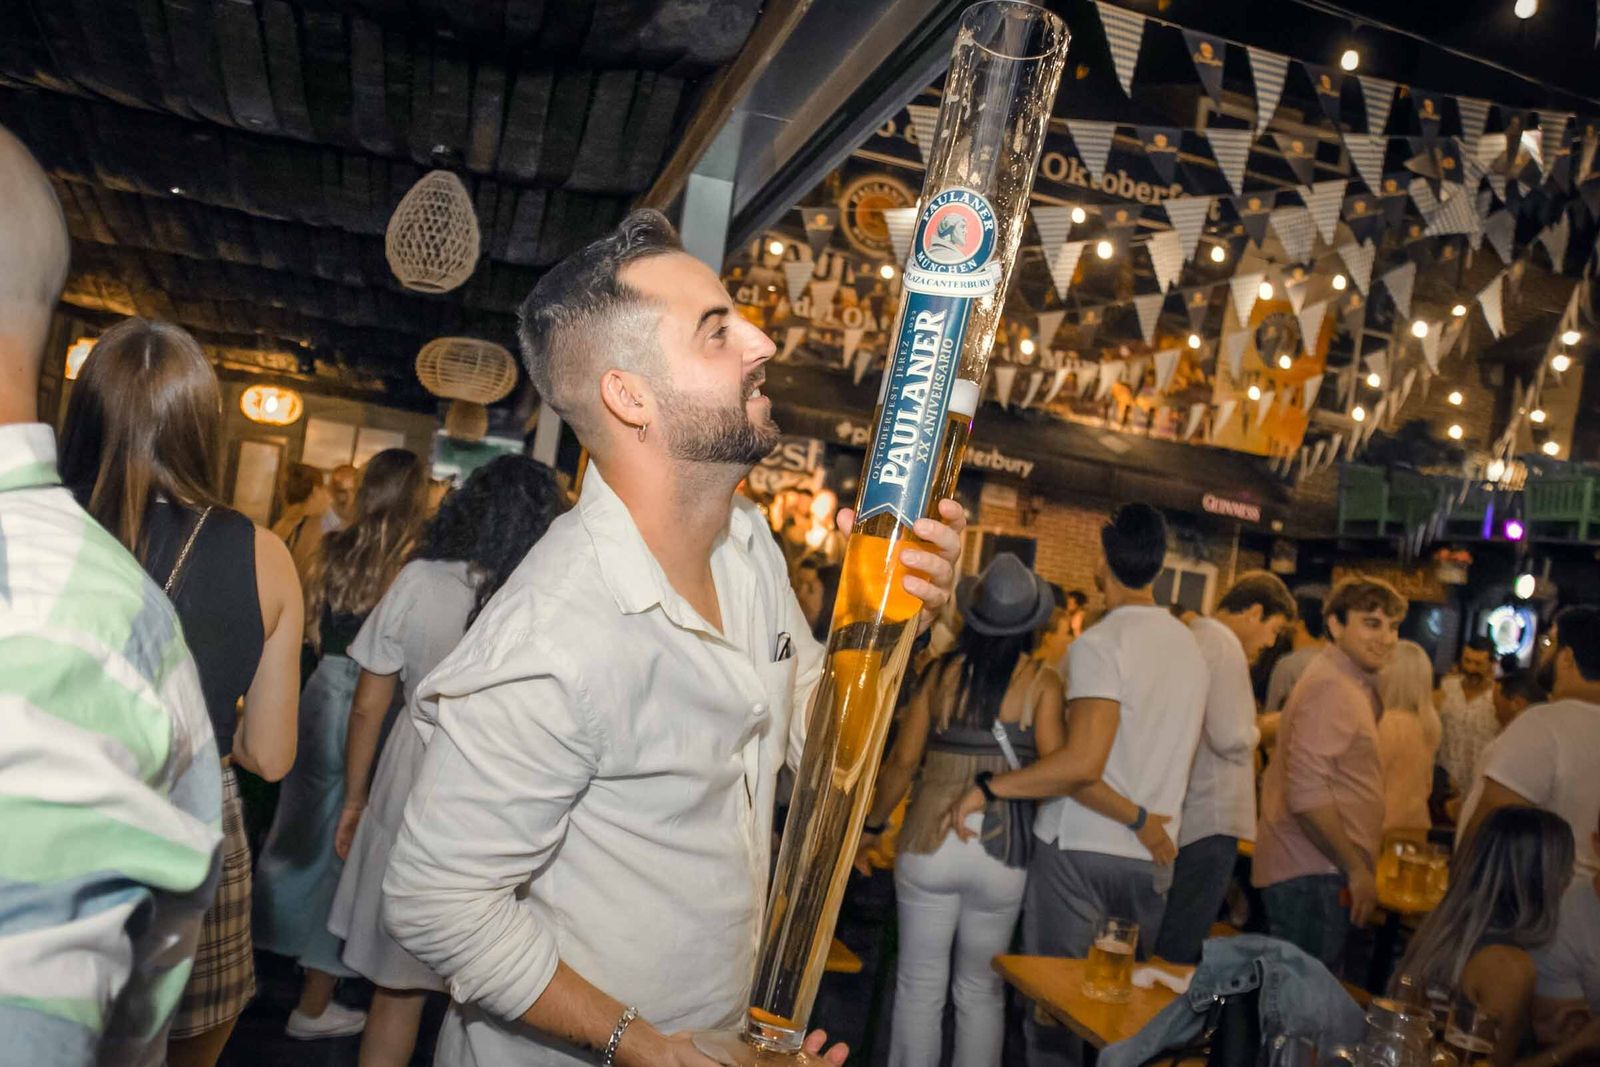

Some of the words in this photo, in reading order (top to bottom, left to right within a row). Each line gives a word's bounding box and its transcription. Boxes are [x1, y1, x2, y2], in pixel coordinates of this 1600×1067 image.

[922, 191, 994, 231] PAULANER
[1041, 151, 1221, 221] Okoberft
[925, 278, 992, 289] CANTERBURY
[872, 385, 899, 479] OKTOBERFEST
[896, 340, 910, 378] JEREZ
[878, 308, 948, 487] PAULANER
[923, 338, 954, 437] ANIVERSARIO
[916, 439, 931, 463] XX
